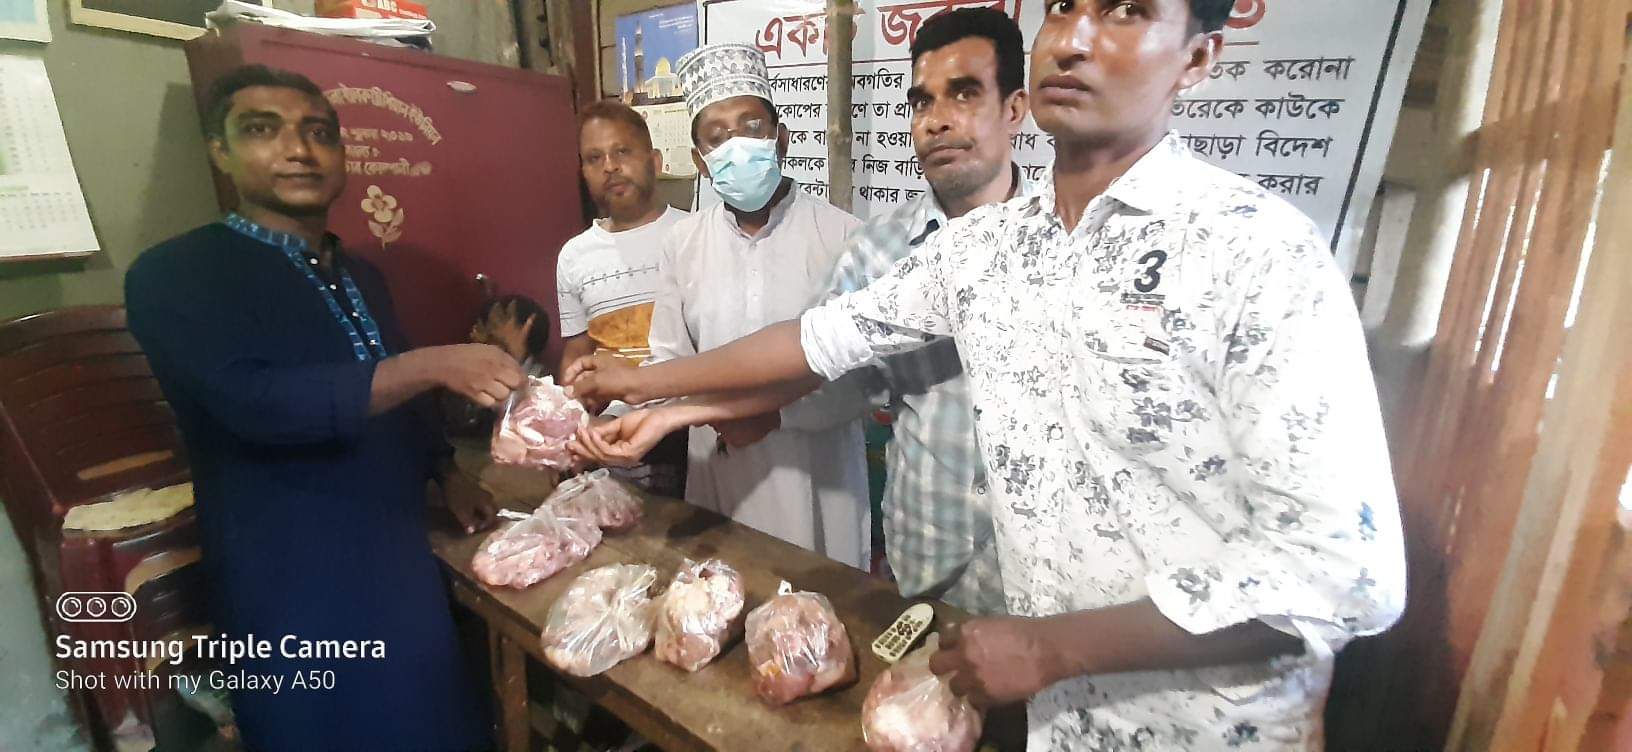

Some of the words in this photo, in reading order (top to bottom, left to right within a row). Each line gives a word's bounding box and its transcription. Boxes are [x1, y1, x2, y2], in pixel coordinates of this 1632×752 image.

[852, 68, 905, 90] বগতির
[1264, 56, 1356, 81] করোনা
[873, 101, 891, 119] তা
[1255, 92, 1345, 119] কাউকে
[855, 131, 871, 147] না
[1256, 129, 1333, 157] বিদেশ
[862, 154, 890, 172] নিজ
[1256, 174, 1324, 195] করার
[859, 185, 900, 203] থাকার
[1134, 249, 1168, 293] 3
